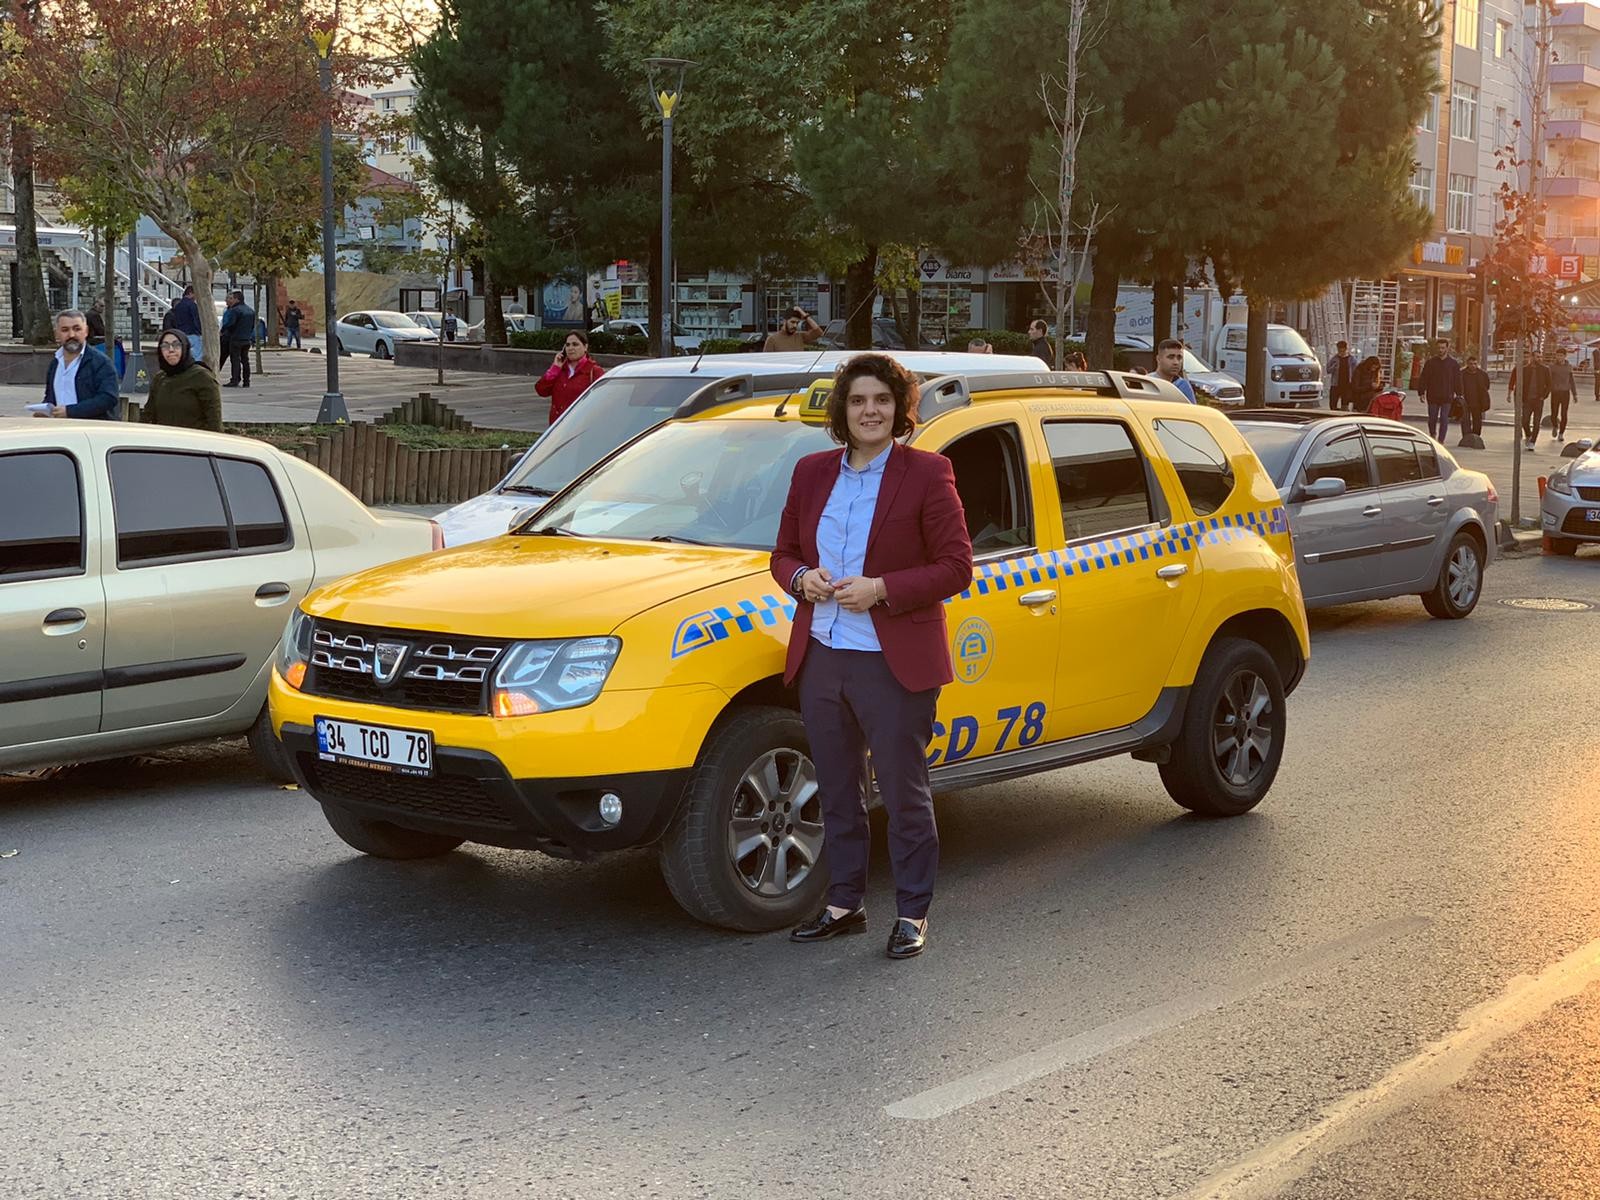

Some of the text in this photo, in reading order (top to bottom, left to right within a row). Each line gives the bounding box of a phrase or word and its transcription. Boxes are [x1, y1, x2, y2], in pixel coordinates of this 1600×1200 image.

[923, 261, 939, 270] ABS
[1033, 374, 1107, 386] DUSTER
[994, 701, 1046, 752] 78
[327, 723, 428, 764] 34 TCD 78
